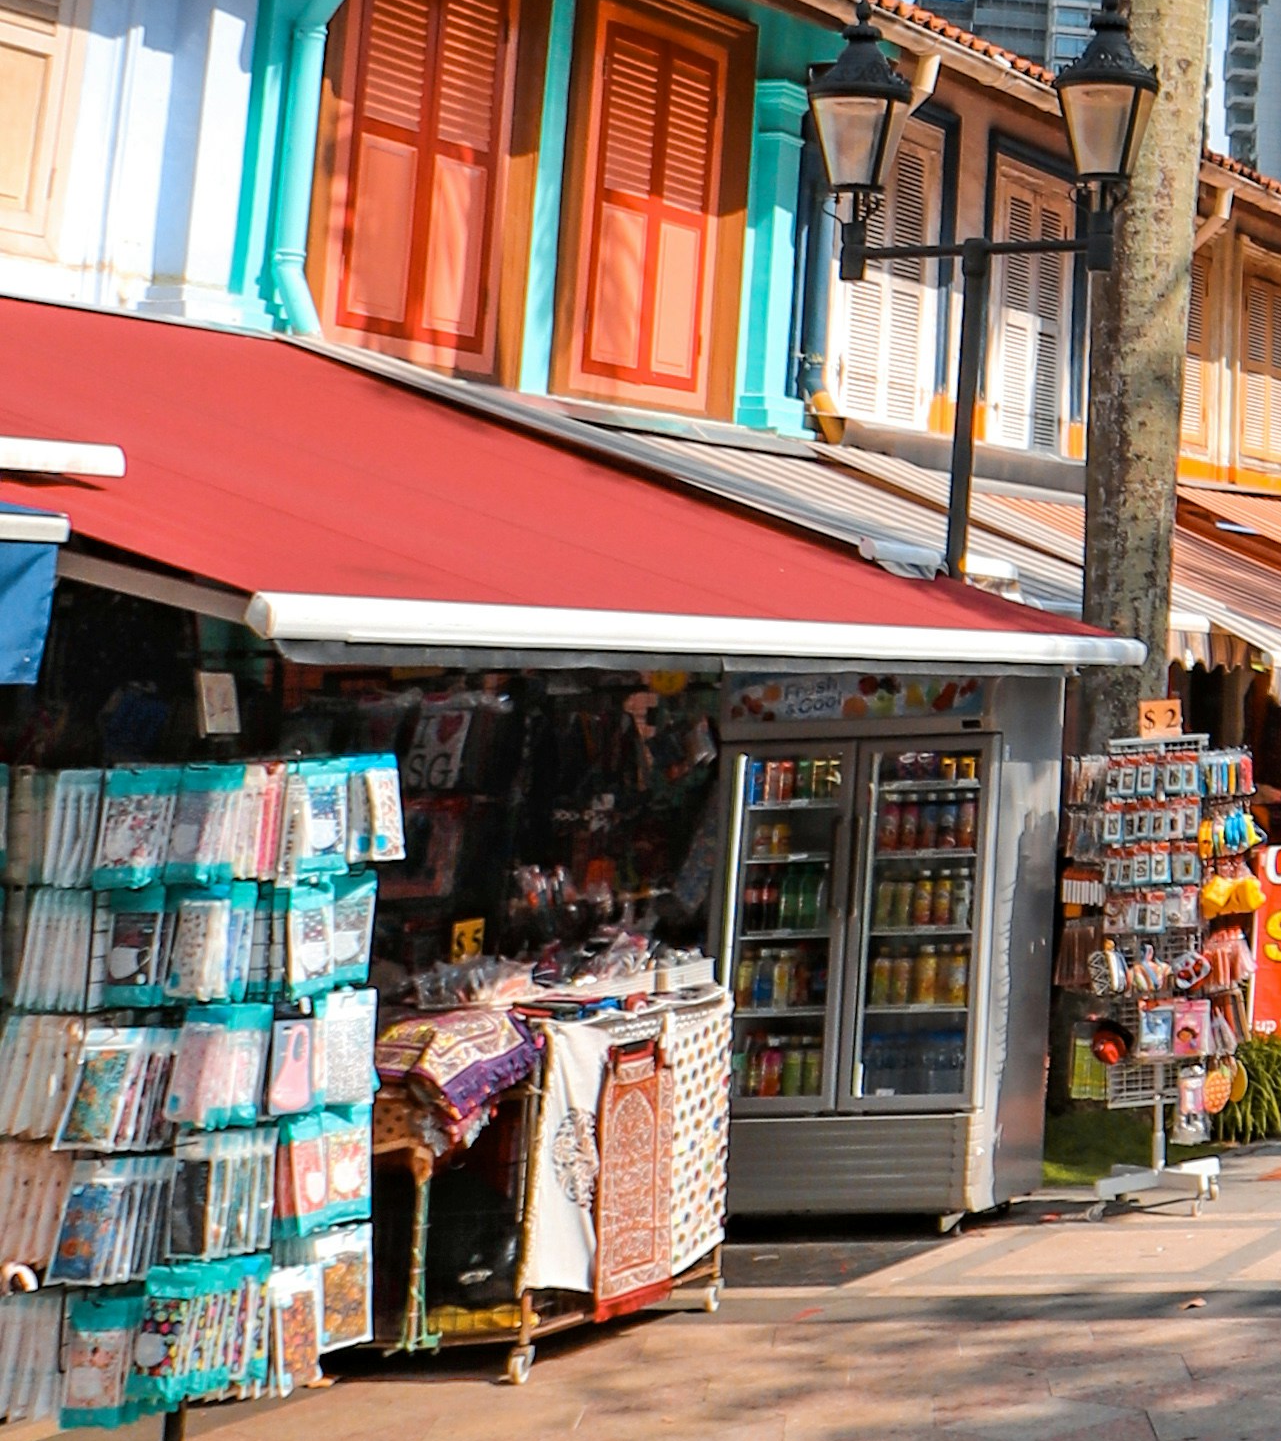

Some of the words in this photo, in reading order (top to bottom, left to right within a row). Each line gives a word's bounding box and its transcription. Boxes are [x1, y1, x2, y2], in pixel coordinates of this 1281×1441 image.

[784, 676, 838, 701] Fresh
[798, 692, 843, 715] Cool
[414, 717, 430, 750] I
[408, 752, 453, 788] SG
[1254, 1019, 1277, 1035] up
